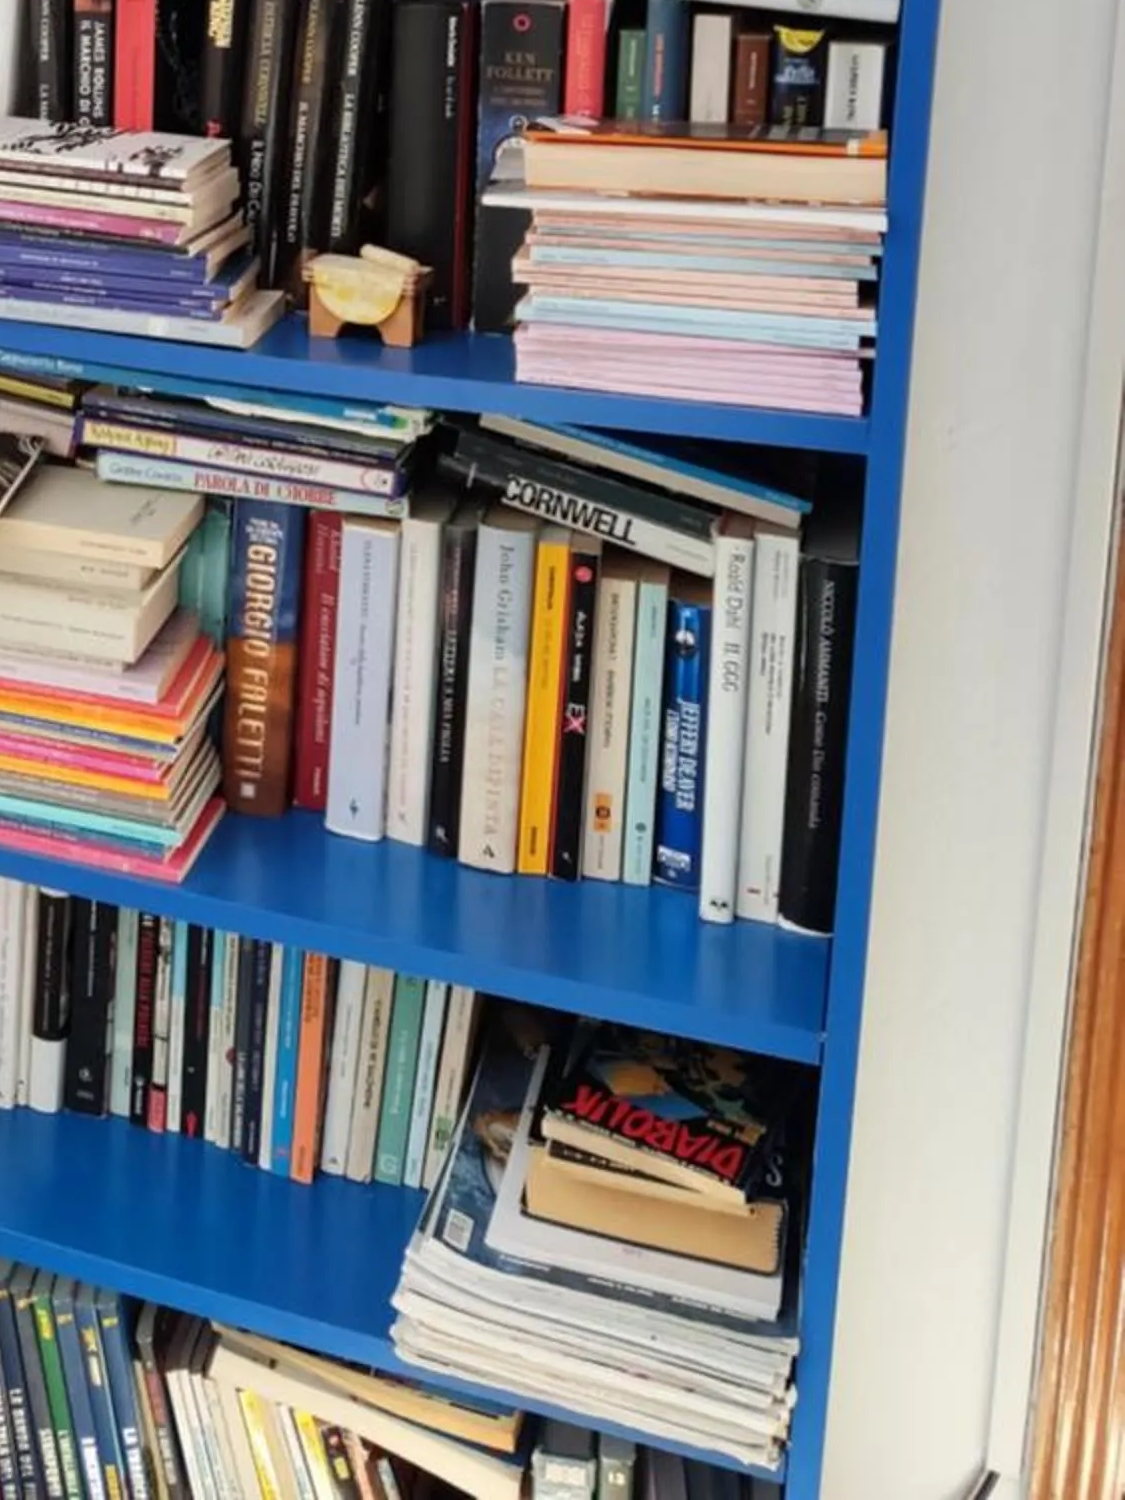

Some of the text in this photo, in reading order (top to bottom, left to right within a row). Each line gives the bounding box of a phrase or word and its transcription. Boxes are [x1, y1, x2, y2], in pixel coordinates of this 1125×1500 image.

[81, 19, 91, 29] IL
[93, 22, 106, 62] JAMES
[346, 29, 362, 76] COOPER
[486, 66, 555, 83] FOLLETT
[504, 52, 536, 65] KEN
[194, 471, 251, 495] PAROLA
[253, 479, 271, 498] DI
[504, 473, 637, 546] CORNWELL
[499, 544, 515, 586] John
[242, 544, 277, 660] GIORGIO
[494, 588, 512, 660] Grisham
[234, 666, 269, 780] FALETTI
[676, 698, 700, 812] JEFFERY DEAVER
[561, 1084, 745, 1182] DIABOLIK
